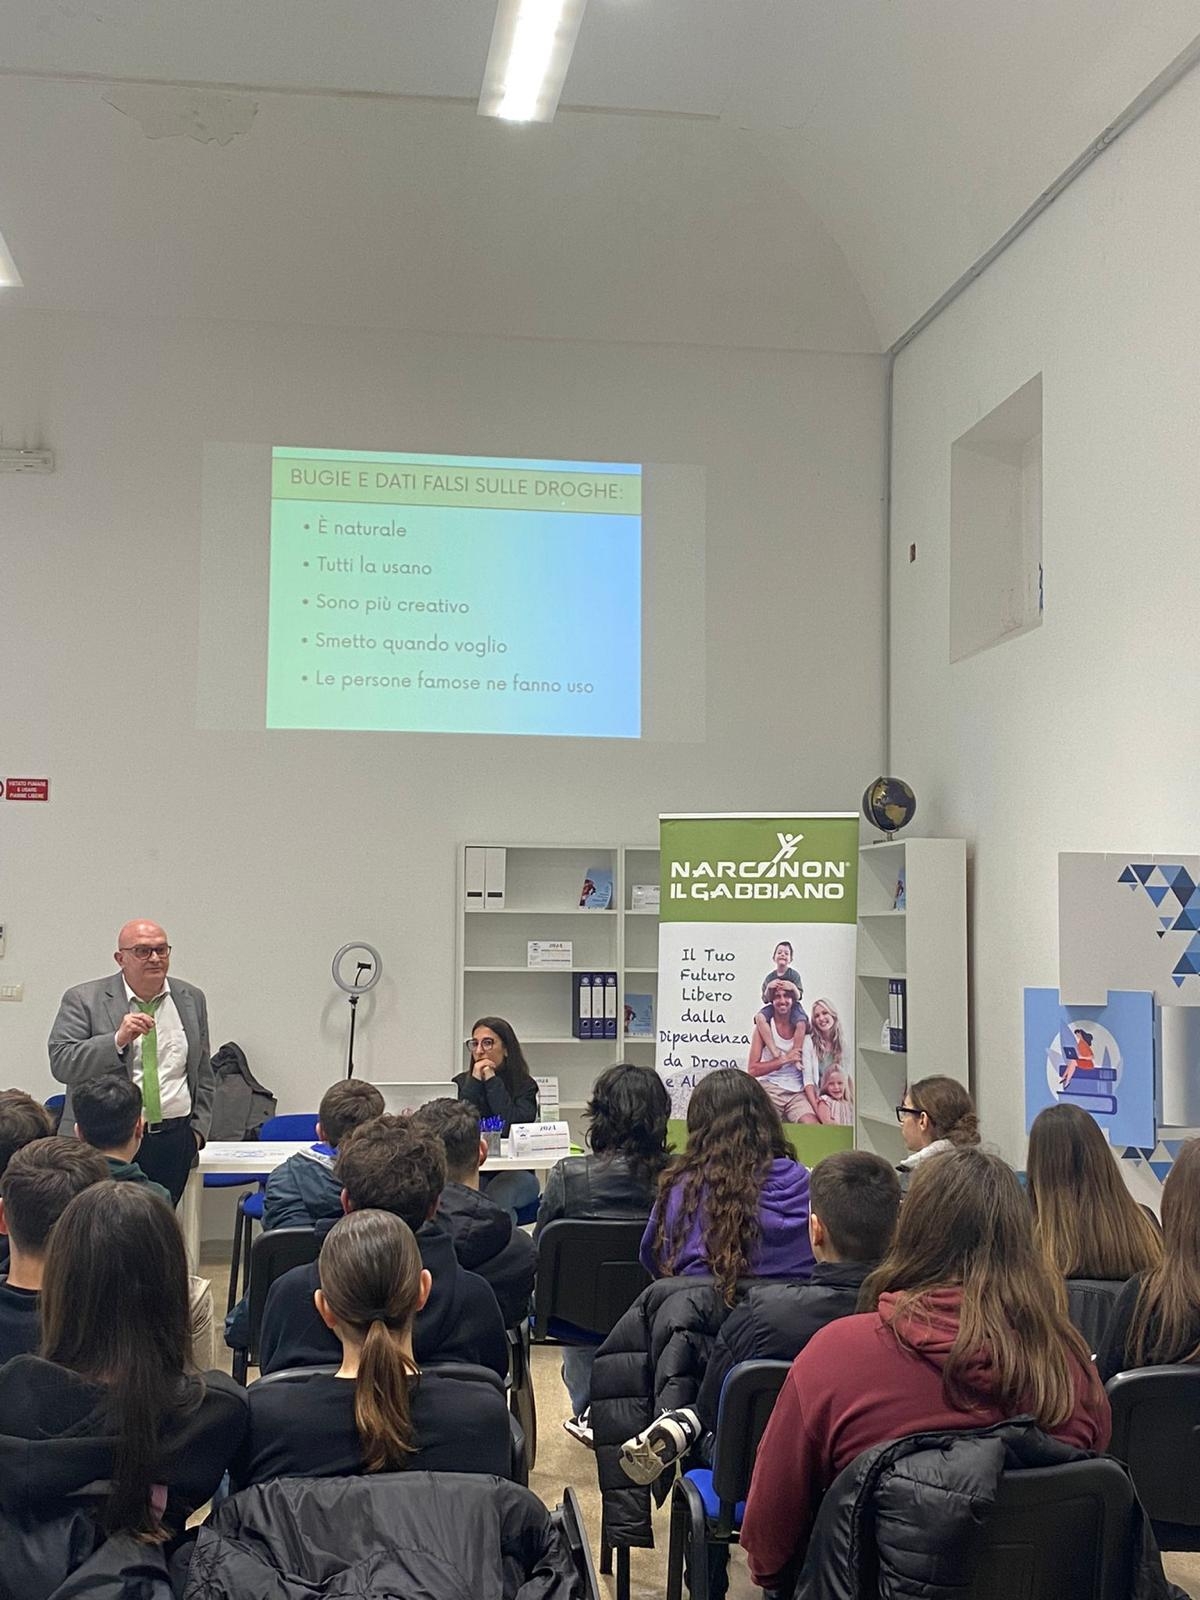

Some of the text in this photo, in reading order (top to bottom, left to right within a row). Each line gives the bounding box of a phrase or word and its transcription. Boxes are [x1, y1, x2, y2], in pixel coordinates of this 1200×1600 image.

[291, 468, 623, 500] BUGIE E DATI FALSI SULLE DROGHE:
[318, 514, 407, 537] È naturale
[317, 555, 432, 576] Tutti la usano
[316, 593, 470, 616] Sono più creativo
[316, 632, 508, 658] Smetto quando voglio
[316, 669, 594, 694] Le persone famose ne fanno uso
[671, 861, 845, 878] NARCONON
[670, 883, 844, 901] IL GABBIANO
[681, 948, 735, 962] Il Tuo
[680, 968, 735, 982] Futuro
[682, 986, 732, 1002] Libero
[681, 1008, 726, 1024] dalla
[659, 1029, 750, 1050] Dipendenza
[663, 1053, 738, 1069] da Droga
[665, 1079, 675, 1088] e
